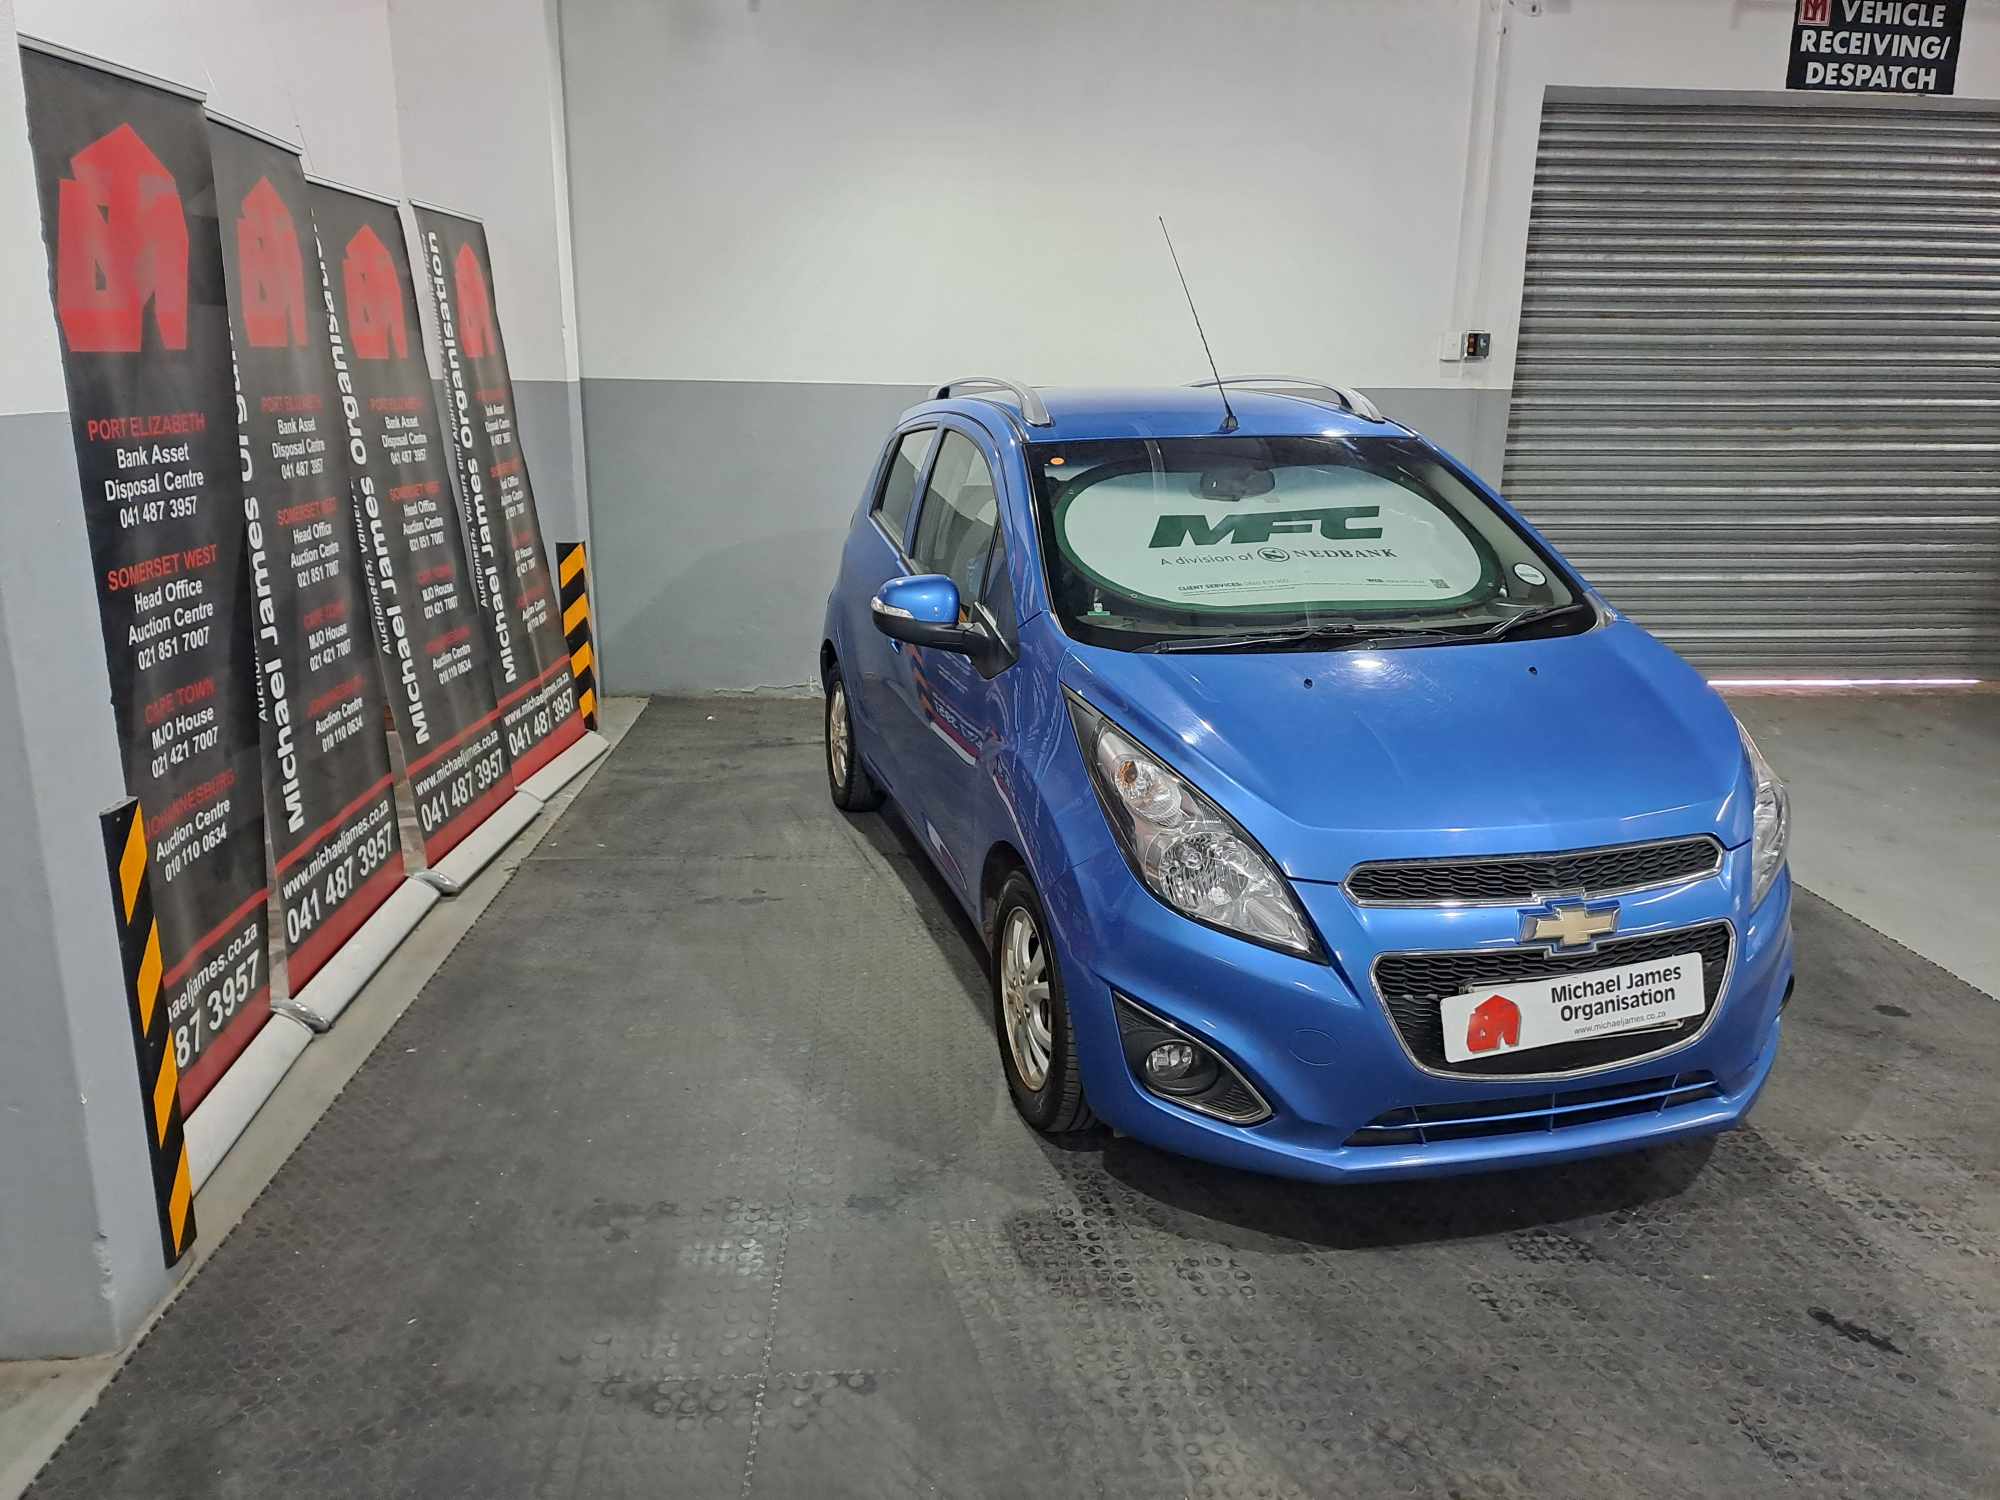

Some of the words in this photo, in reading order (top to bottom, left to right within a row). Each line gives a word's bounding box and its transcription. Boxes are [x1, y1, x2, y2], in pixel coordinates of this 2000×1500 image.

[1841, 0, 1947, 28] VEHICLE
[1800, 29, 1951, 60] RECEIVING/
[1805, 61, 1937, 90] DESPATCH
[428, 231, 473, 449] Organisation
[87, 417, 127, 441] PORT
[116, 448, 149, 469] Bank
[151, 442, 190, 464] Asset
[105, 475, 160, 502] Disposal
[164, 468, 204, 491] Centre
[467, 458, 494, 558] James
[120, 506, 140, 529] 041
[143, 501, 164, 523] 487
[170, 496, 198, 518] 3957
[360, 476, 397, 595] James
[1148, 505, 1384, 548] MFC
[107, 555, 180, 592] SOMERSET
[184, 544, 219, 568] WEST
[244, 496, 279, 646] James
[1160, 558, 1172, 566] A
[1175, 554, 1234, 566] division
[1238, 552, 1254, 561] of
[1293, 548, 1398, 558] NEDBANK
[134, 588, 162, 615] Head
[165, 579, 203, 602] Office
[128, 615, 171, 646] Auction
[174, 601, 214, 625] Centre
[485, 566, 518, 684] Michael
[138, 647, 156, 671] 021
[158, 640, 178, 661] 851
[182, 626, 210, 652] 7007
[386, 604, 430, 745] Michael
[151, 726, 173, 750] MJO
[176, 707, 215, 735] House
[508, 722, 532, 757] 041
[552, 687, 574, 722] 3957
[151, 755, 168, 778] 021
[169, 743, 189, 765] 421
[193, 726, 219, 749] 7007
[264, 658, 305, 833] Michael
[421, 791, 449, 832] 041
[451, 771, 474, 808] 487
[475, 748, 504, 790] 3957
[156, 822, 193, 862] Auction
[195, 799, 231, 830] Centre
[165, 855, 181, 882] 010
[182, 840, 200, 866] 110
[202, 822, 228, 854] 0634
[282, 799, 389, 900] www.michaeljames.co.za
[286, 887, 321, 944] 041
[325, 856, 353, 905] 487
[358, 821, 392, 877] 3957
[1551, 975, 1621, 1003] Michael
[1626, 966, 1682, 990] James
[1560, 987, 1676, 1022] Organisation
[174, 1009, 201, 1068] 87
[206, 948, 260, 1031] 3957
[1574, 1010, 1666, 1035] www.michaeljames.co.za
